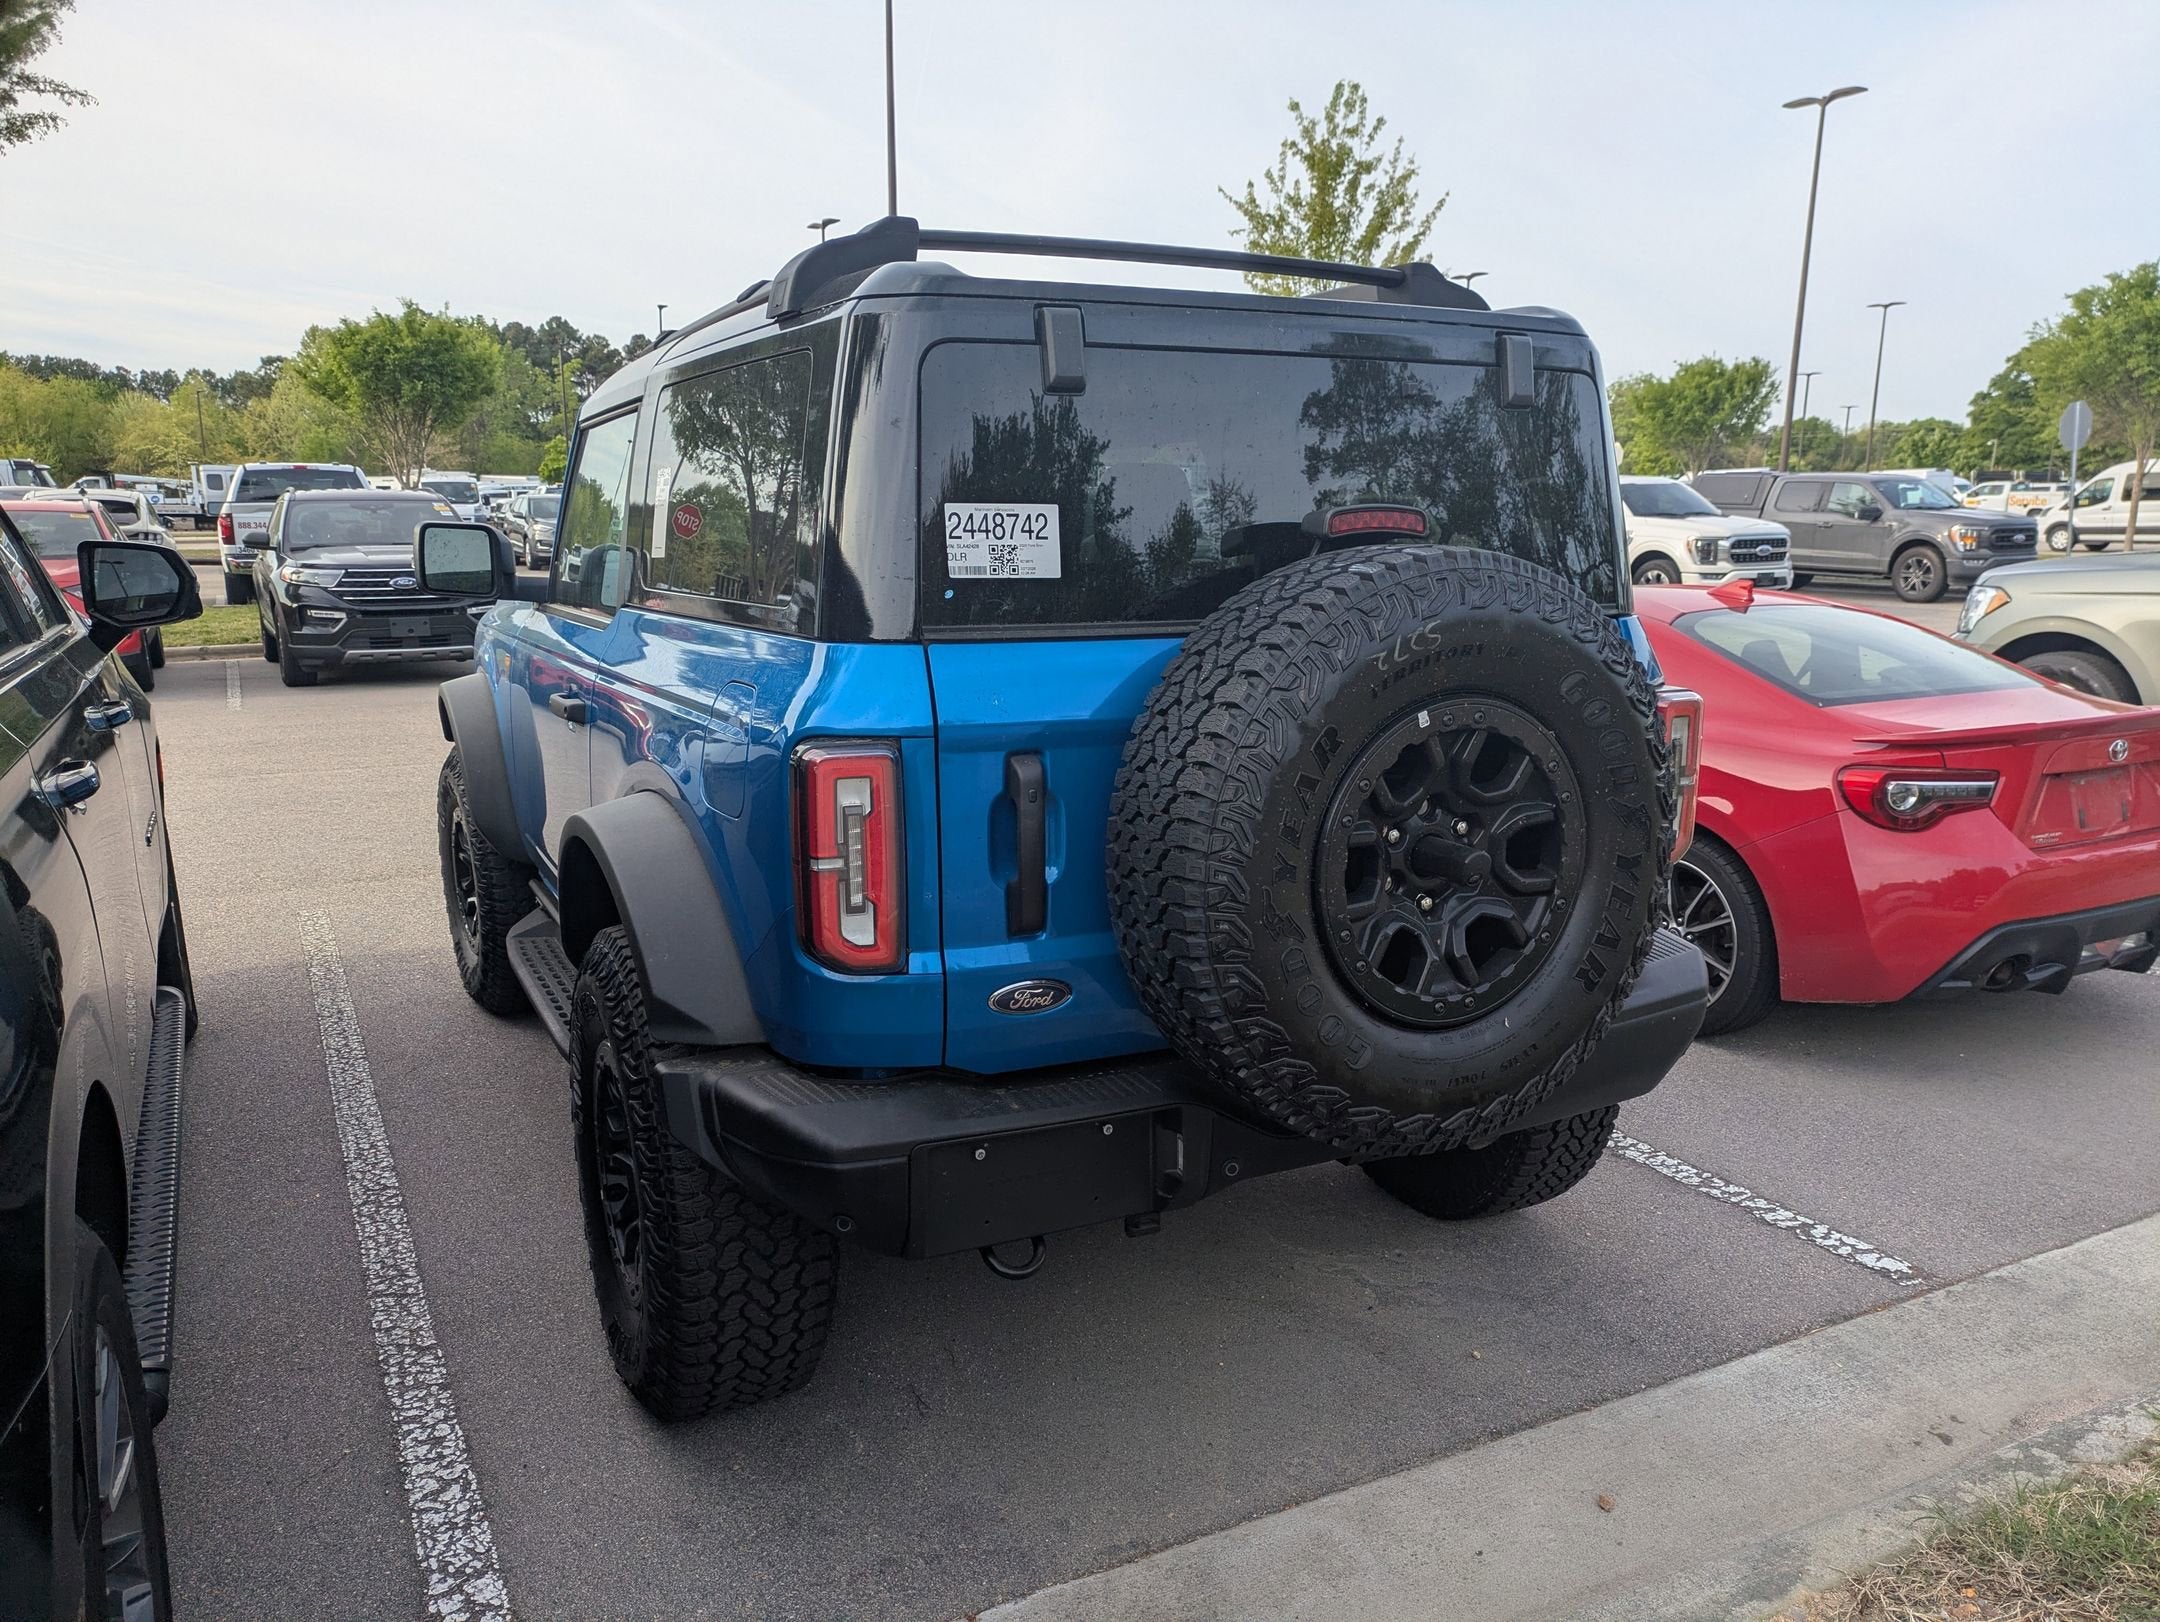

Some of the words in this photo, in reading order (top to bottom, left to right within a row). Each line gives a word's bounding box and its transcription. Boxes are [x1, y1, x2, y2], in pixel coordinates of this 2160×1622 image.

[2009, 495, 2048, 506] Service
[948, 512, 1048, 540] 2448742
[1009, 988, 1053, 1009] Ford
